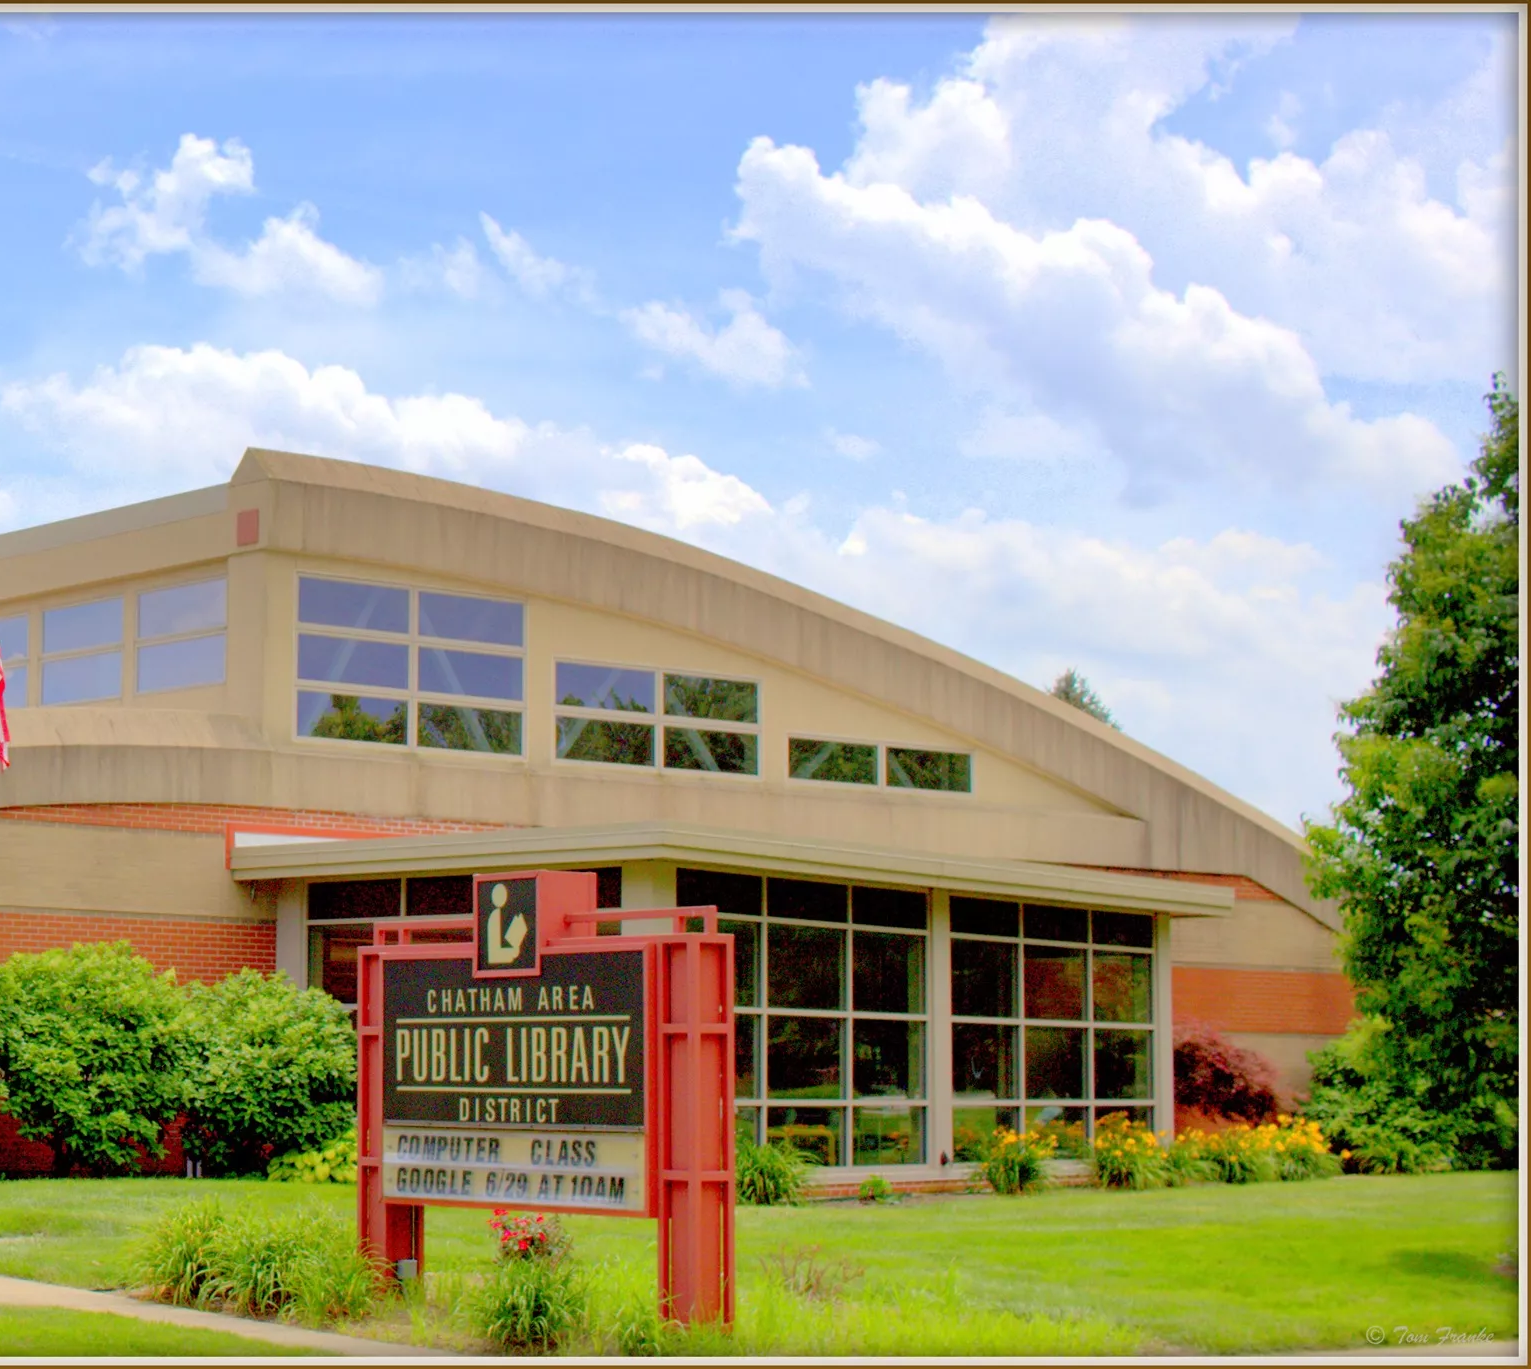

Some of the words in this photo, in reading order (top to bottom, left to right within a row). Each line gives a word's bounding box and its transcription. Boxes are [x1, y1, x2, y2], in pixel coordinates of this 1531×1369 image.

[427, 987, 522, 1013] CHATHAM
[537, 985, 595, 1011] AREA
[396, 1027, 490, 1083] PUBLIC
[506, 1026, 630, 1083] LIBRARY
[459, 1098, 559, 1123] DISTRICT
[397, 1134, 501, 1163] COMPUTER
[531, 1139, 597, 1167] CLASS
[396, 1167, 472, 1195] GOOGLE
[486, 1171, 528, 1199] 6/29
[538, 1174, 566, 1200] AT
[571, 1175, 626, 1204] 10AM
